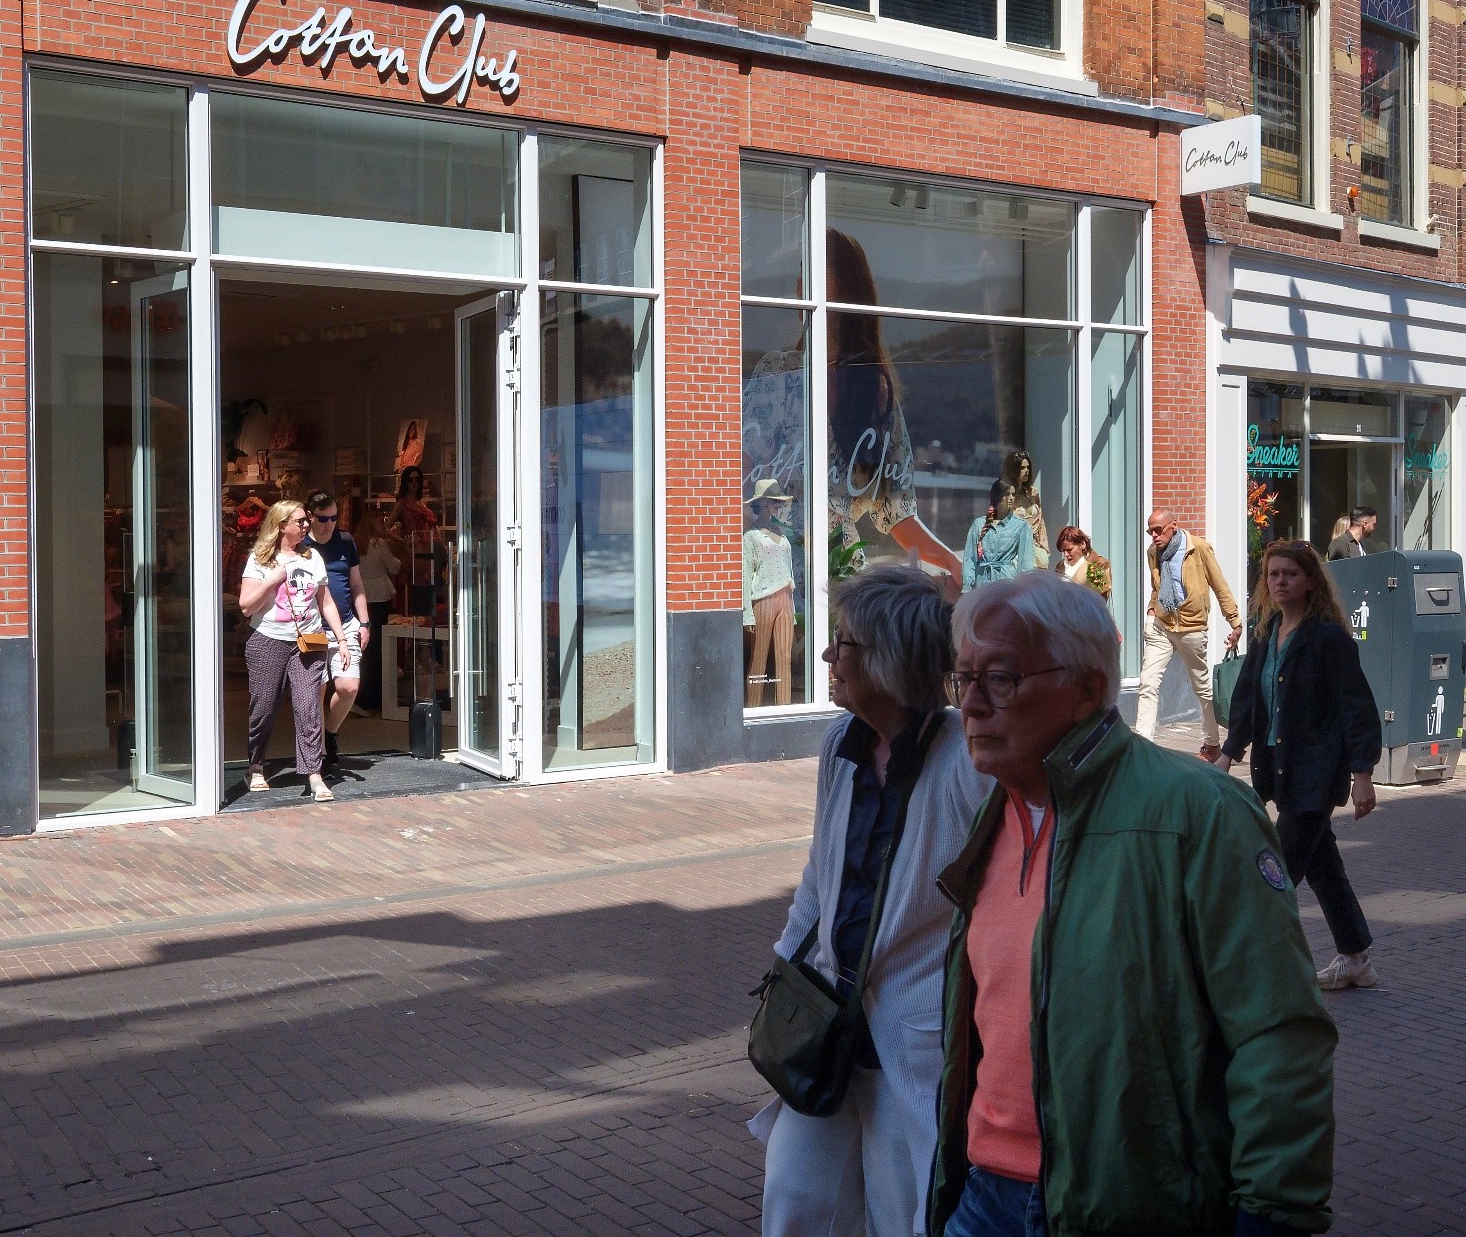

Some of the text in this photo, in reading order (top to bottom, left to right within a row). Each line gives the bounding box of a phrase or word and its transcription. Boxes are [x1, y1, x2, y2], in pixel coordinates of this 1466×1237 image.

[419, 4, 521, 105] Club
[1185, 140, 1249, 173] Cotton Club
[847, 427, 913, 502] Club
[1247, 423, 1301, 467] Sneaker
